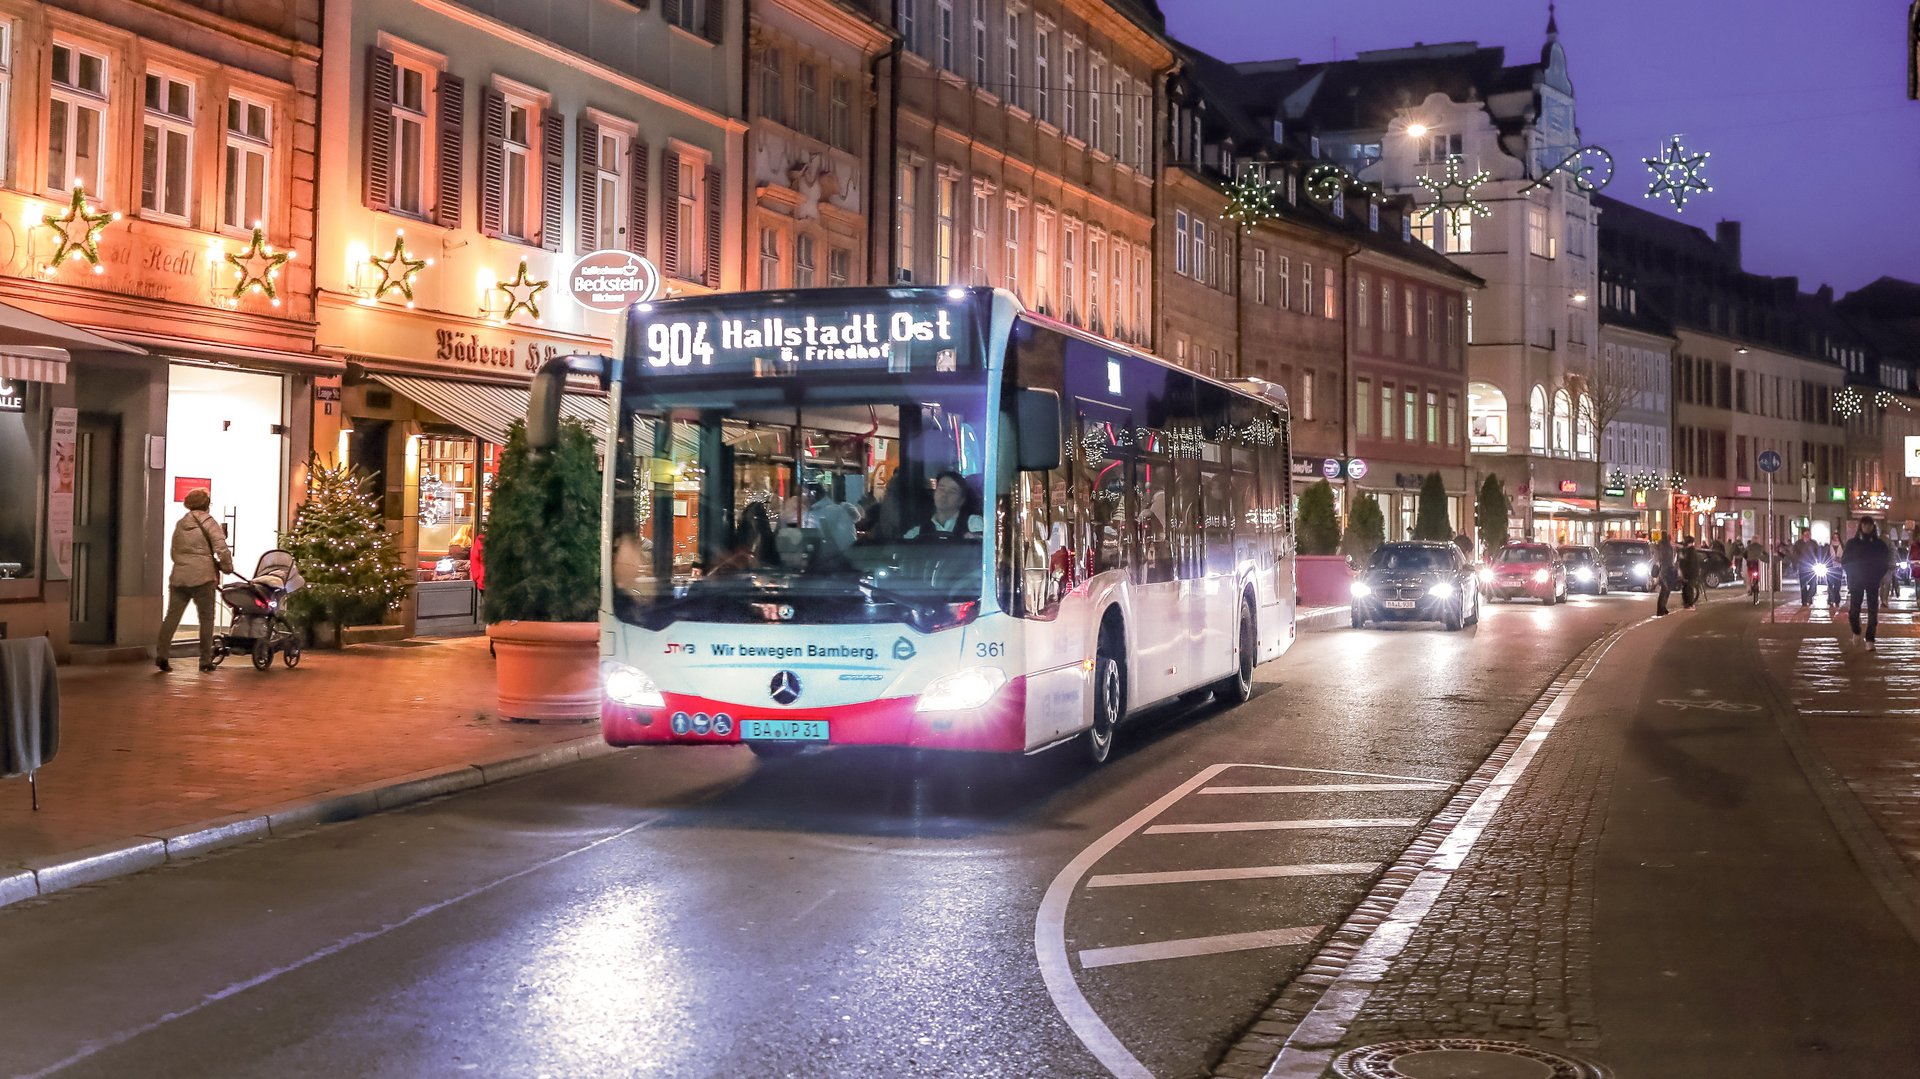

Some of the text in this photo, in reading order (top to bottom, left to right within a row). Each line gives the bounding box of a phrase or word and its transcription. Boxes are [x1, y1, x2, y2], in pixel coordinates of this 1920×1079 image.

[574, 275, 644, 292] Beckstein
[647, 310, 951, 367] 904 Hallstadt Ost
[805, 343, 890, 361] Friedhof
[711, 643, 736, 656] Wir
[739, 644, 802, 660] bewegen
[807, 644, 878, 660] Bamberg.
[976, 642, 1005, 658] 361
[753, 722, 820, 738] BA VP 31
